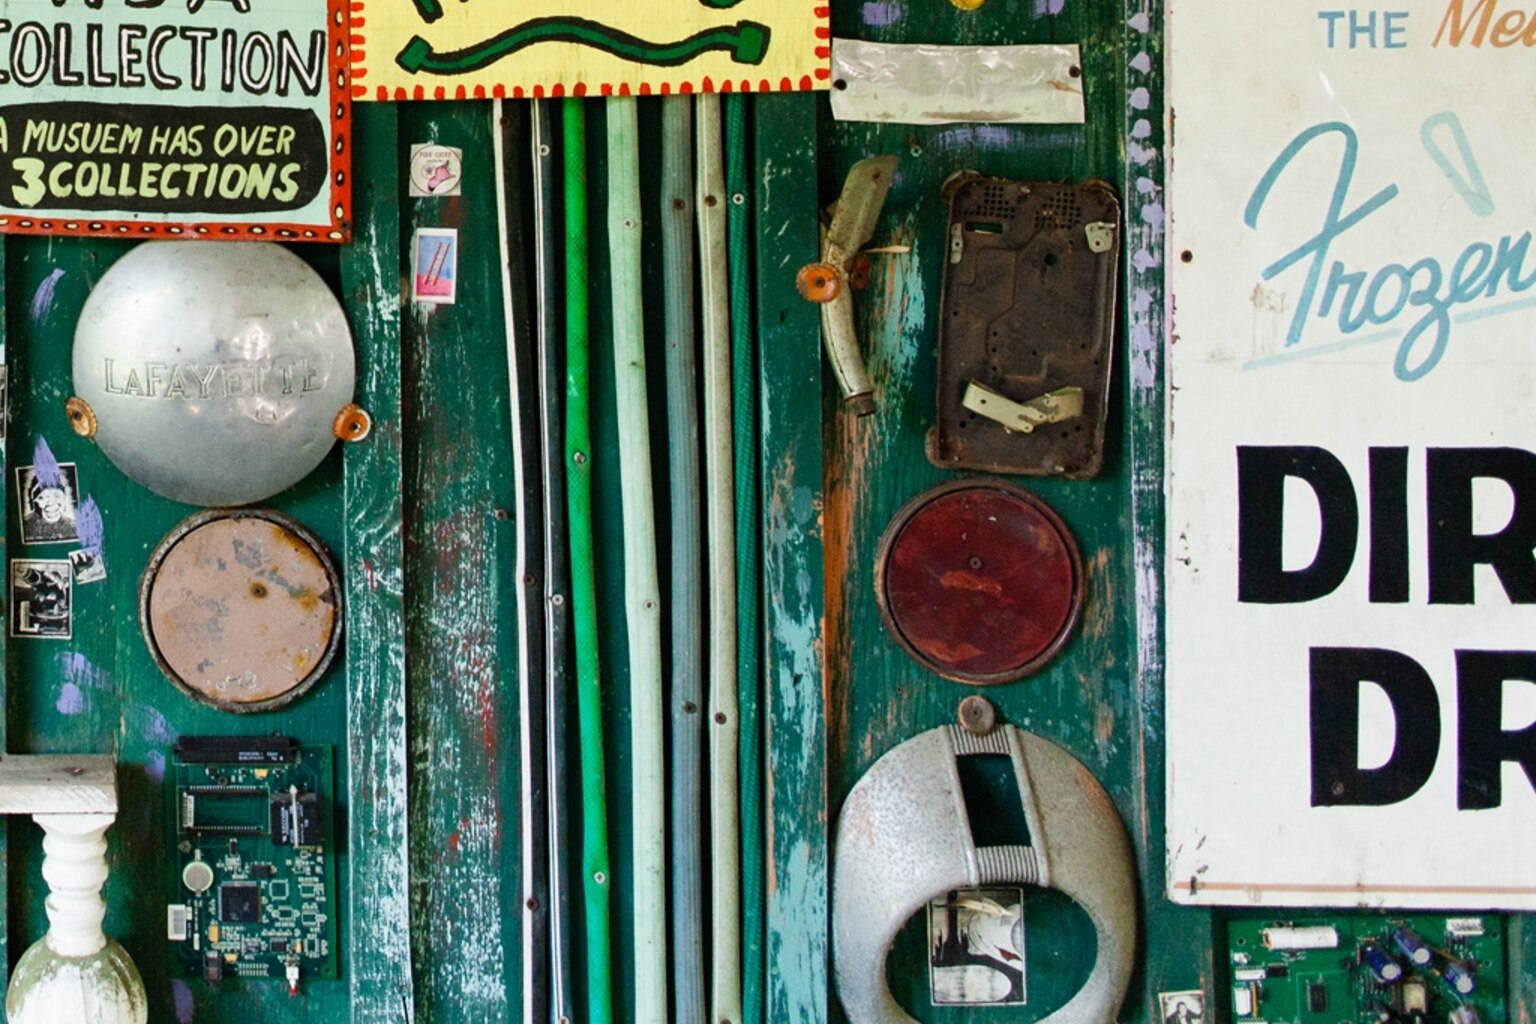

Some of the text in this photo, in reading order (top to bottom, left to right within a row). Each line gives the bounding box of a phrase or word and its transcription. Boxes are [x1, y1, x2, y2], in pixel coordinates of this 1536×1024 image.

[1318, 9, 1410, 50] THE
[21, 118, 143, 156] MUSUEM
[148, 124, 206, 156] HAS
[212, 122, 297, 157] OVER
[1244, 120, 1536, 383] Frozen
[104, 354, 322, 400] LAFAYETTE
